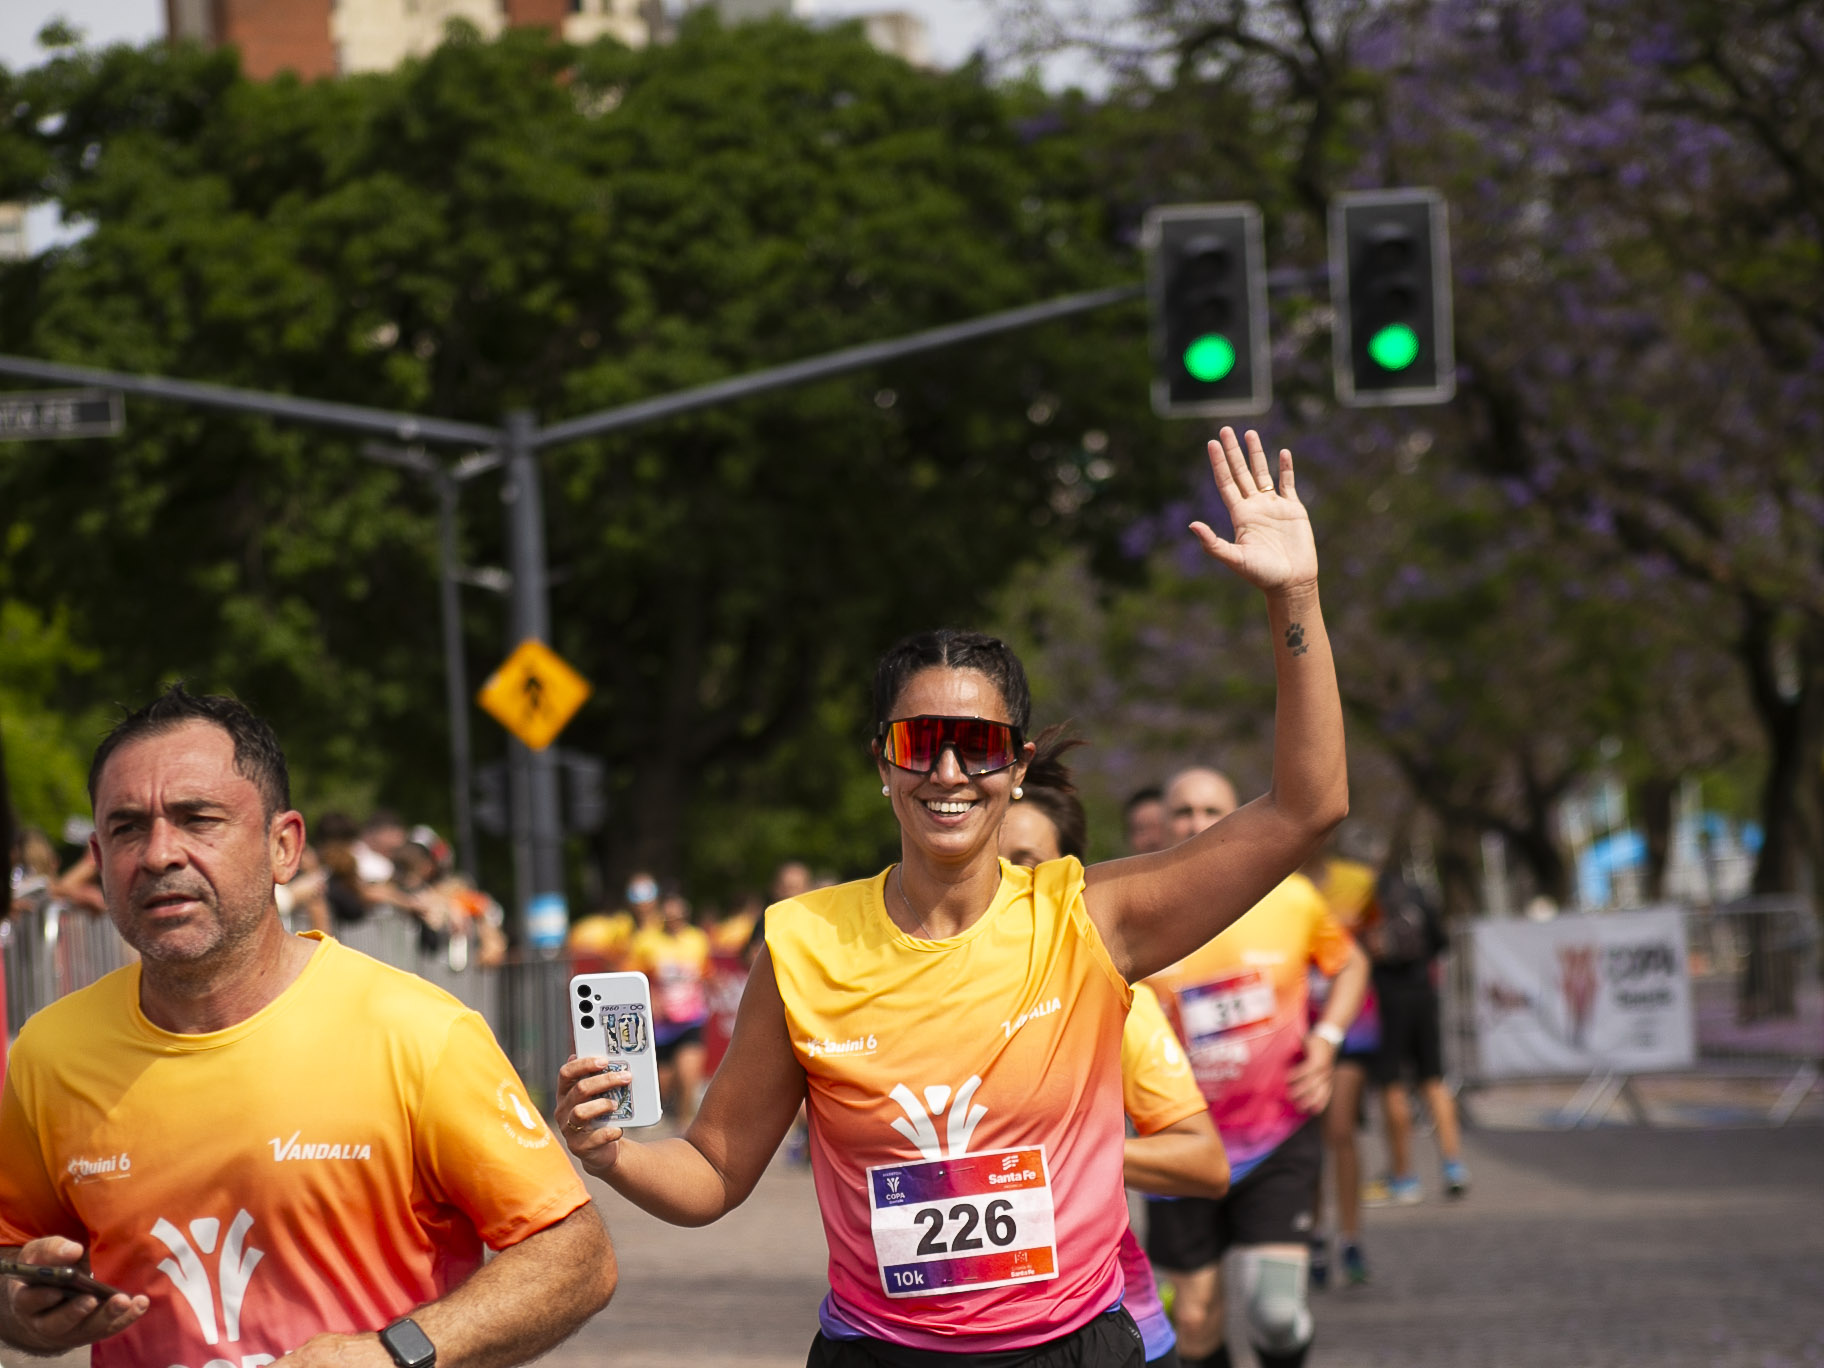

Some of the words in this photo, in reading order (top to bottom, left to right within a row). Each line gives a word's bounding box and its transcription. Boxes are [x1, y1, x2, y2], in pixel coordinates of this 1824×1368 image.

[866, 1033, 878, 1050] 6
[267, 1129, 371, 1162] VANDALIA
[119, 1152, 131, 1171] 6
[988, 1172, 1022, 1185] Santa
[1022, 1169, 1036, 1181] Fe
[886, 1192, 906, 1201] COPA
[913, 1199, 1017, 1257] 226
[893, 1269, 924, 1287] 10k
